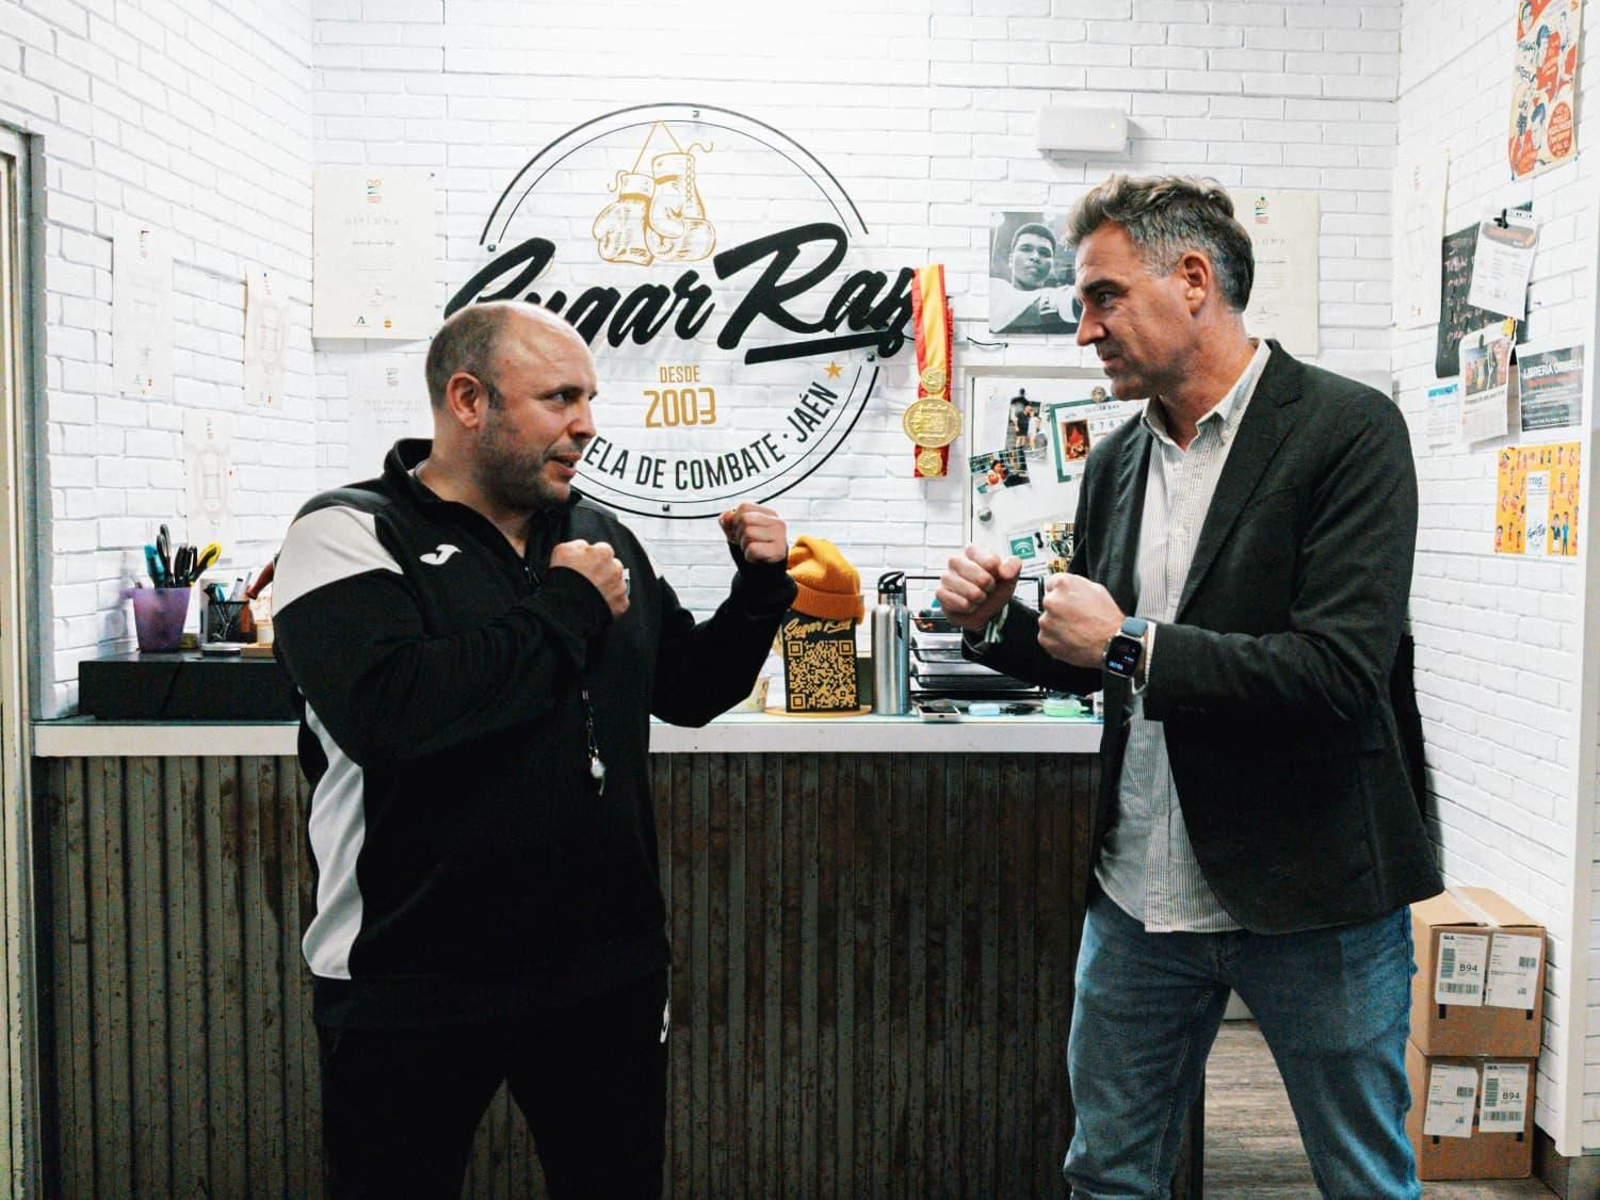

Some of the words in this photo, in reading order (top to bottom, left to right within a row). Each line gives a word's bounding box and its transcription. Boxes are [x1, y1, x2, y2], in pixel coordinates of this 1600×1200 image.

[713, 222, 915, 364] Ray
[660, 365, 700, 383] DESDE
[643, 387, 717, 428] 2003
[583, 435, 629, 480] ELA
[635, 455, 667, 489] DE
[675, 433, 786, 491] COMBATE
[786, 381, 839, 443] JAÉN
[783, 617, 823, 641] Sugar
[1459, 963, 1478, 972] B94
[1502, 1091, 1520, 1100] B94
